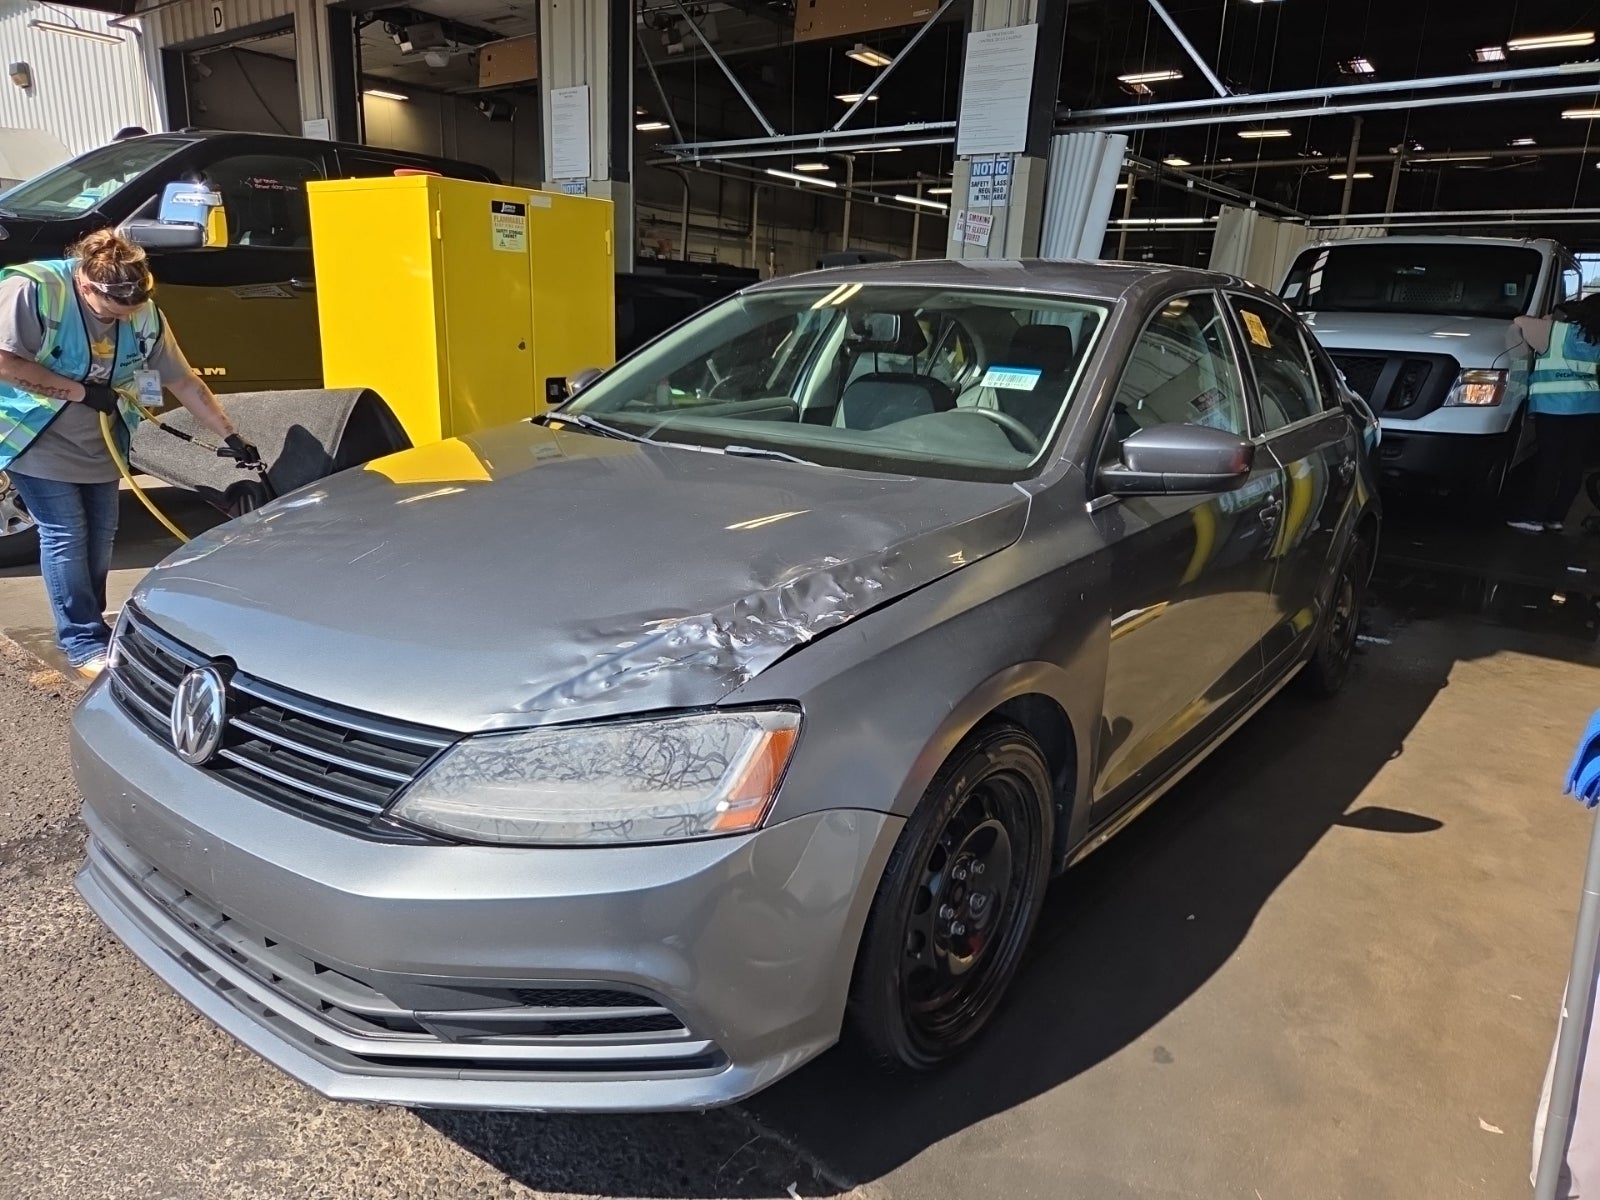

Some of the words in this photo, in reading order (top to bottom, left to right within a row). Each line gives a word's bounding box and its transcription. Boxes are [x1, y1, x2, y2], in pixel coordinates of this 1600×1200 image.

[213, 7, 222, 28] D
[493, 215, 525, 225] FLAMMABLE
[968, 213, 991, 225] SMOKING
[190, 367, 227, 376] AM
